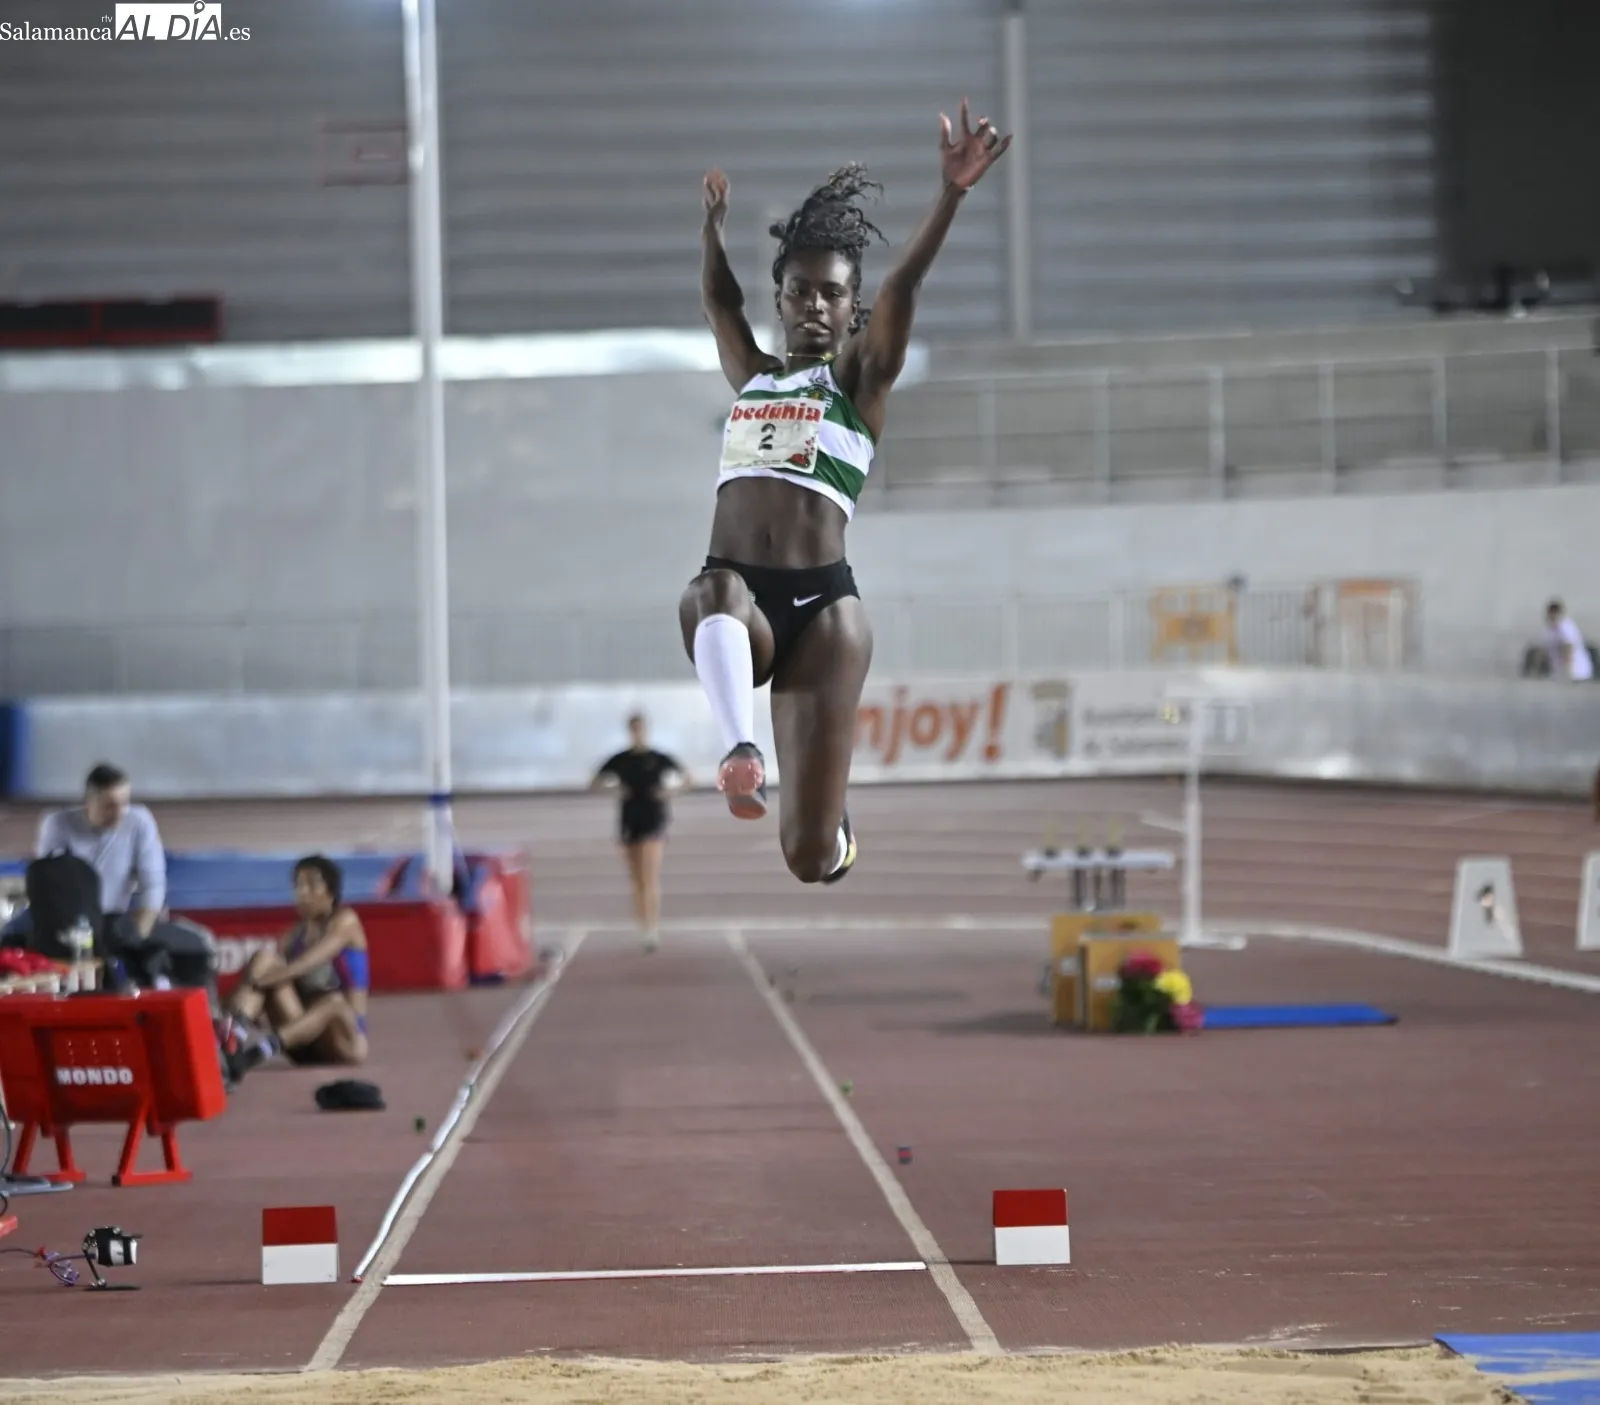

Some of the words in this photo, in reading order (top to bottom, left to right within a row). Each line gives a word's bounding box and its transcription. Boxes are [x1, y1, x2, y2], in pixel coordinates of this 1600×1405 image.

[731, 403, 821, 423] bedunia
[758, 423, 776, 450] 2
[56, 1066, 134, 1086] MONDO
